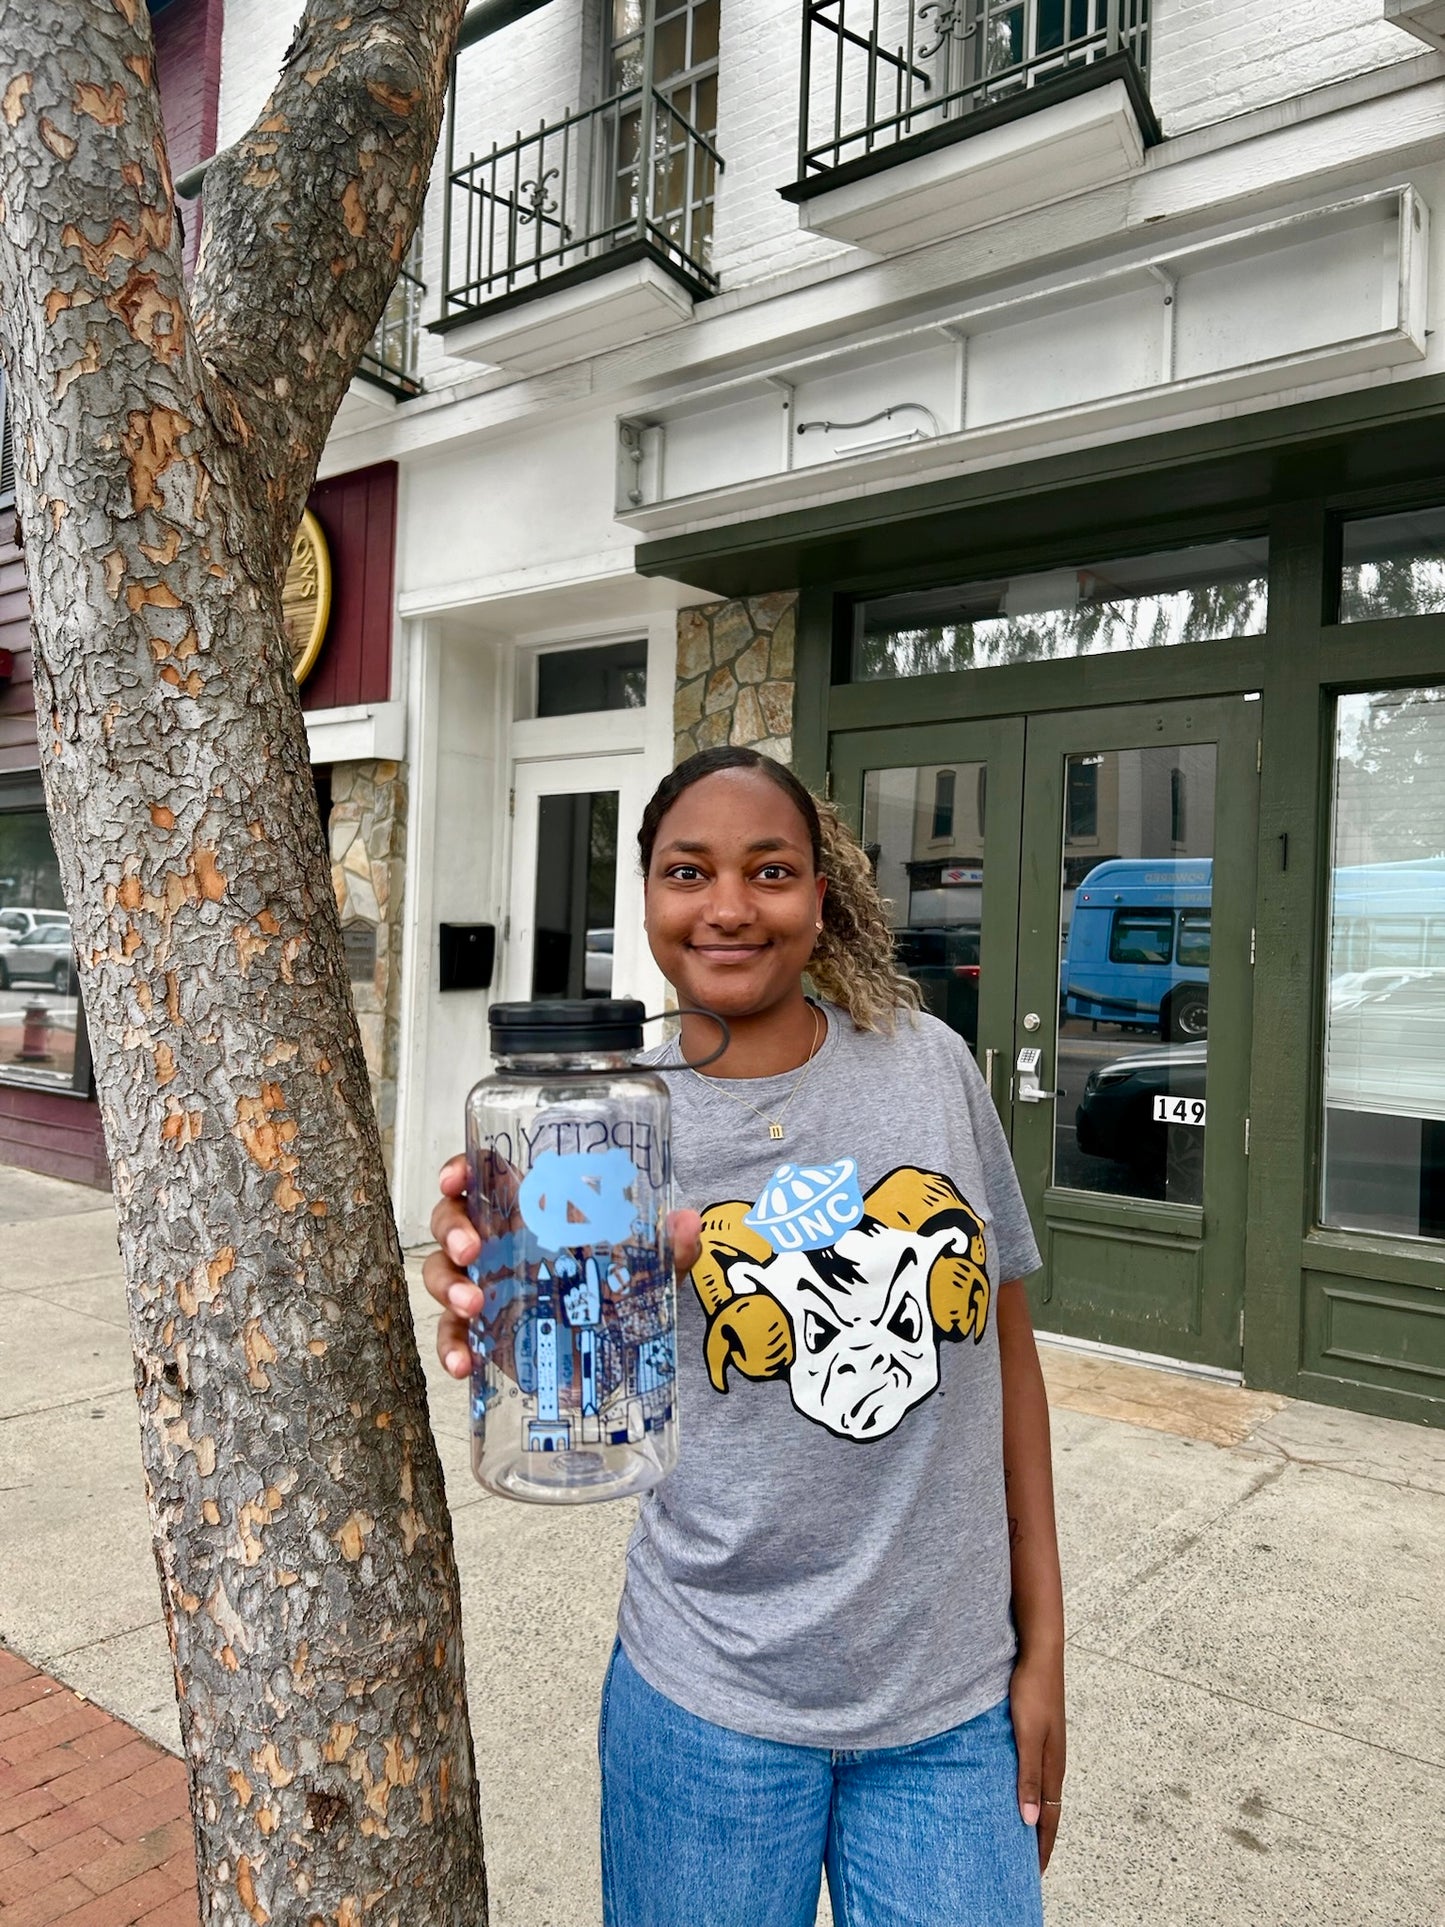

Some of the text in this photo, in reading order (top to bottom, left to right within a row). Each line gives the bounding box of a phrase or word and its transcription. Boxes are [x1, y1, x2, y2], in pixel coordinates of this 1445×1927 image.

[293, 537, 317, 597] OWS
[1157, 1098, 1205, 1124] 149
[769, 1193, 858, 1248] UNC
